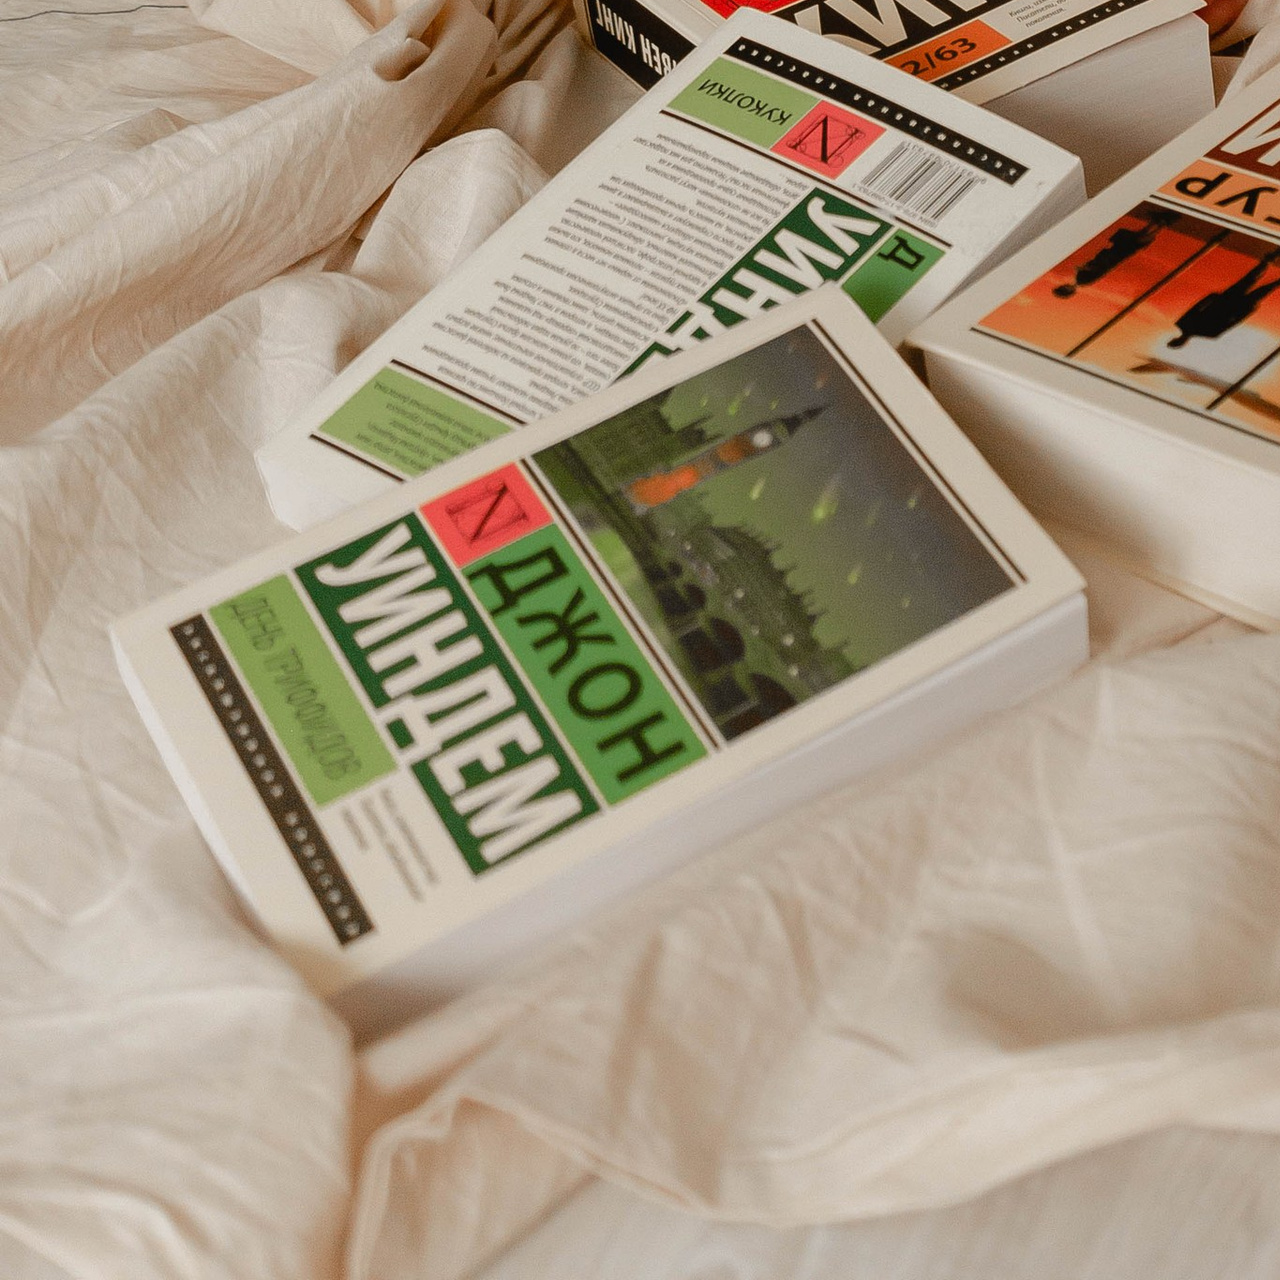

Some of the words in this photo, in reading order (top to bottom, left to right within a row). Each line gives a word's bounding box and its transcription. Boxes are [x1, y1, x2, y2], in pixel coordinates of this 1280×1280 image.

[639, 31, 676, 85] ВЕН
[735, 42, 839, 91] классика
[695, 77, 794, 126] КУКОЛКИ
[463, 534, 691, 793] ДЖОН
[291, 519, 593, 877] УИНДЕМ
